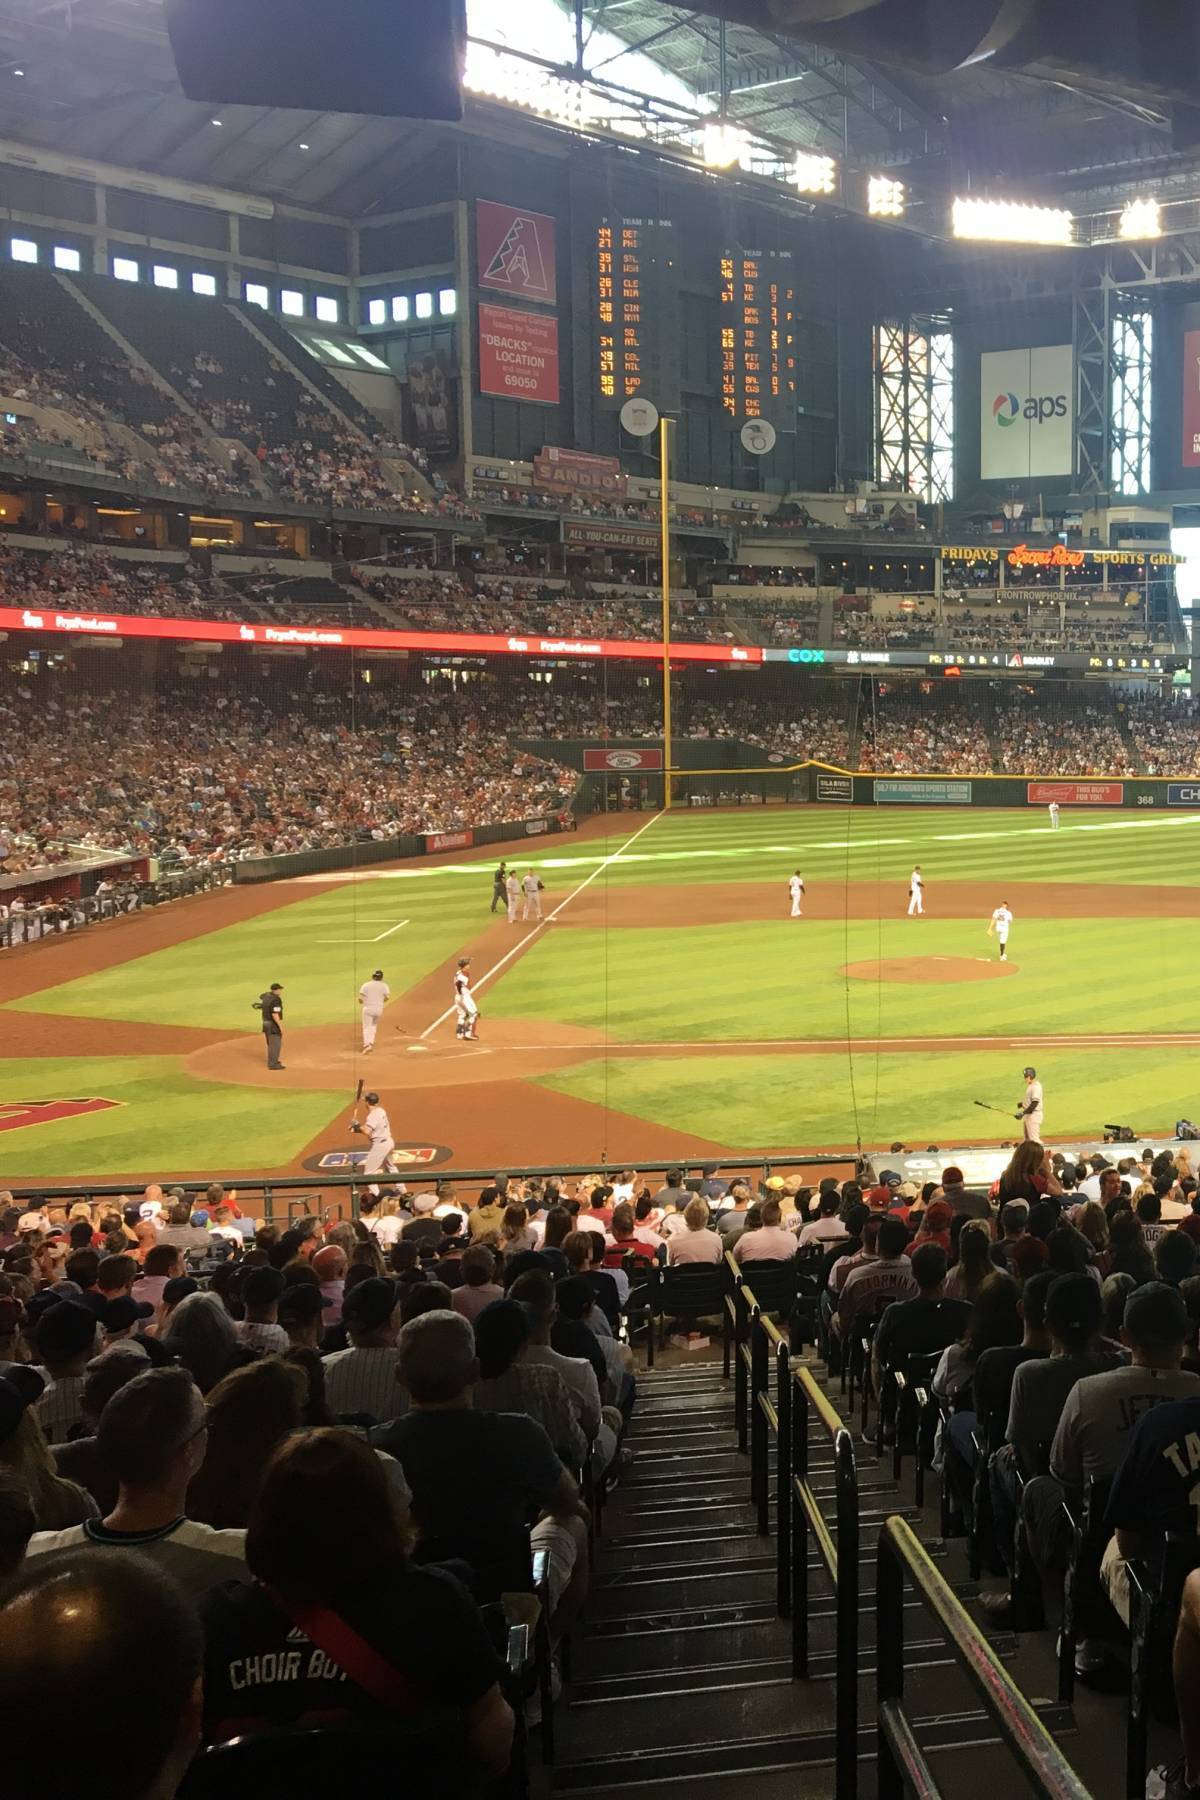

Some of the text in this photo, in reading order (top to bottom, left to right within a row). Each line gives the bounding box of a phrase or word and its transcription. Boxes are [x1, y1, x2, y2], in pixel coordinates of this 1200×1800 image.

[599, 228, 638, 238] 44 DET
[599, 239, 637, 248] 27 PHI
[600, 252, 611, 262] 39
[600, 263, 611, 272] 31
[721, 259, 733, 268] 54
[721, 269, 733, 278] 46
[623, 280, 638, 288] CLE
[600, 288, 612, 297] 31
[721, 292, 733, 301] 57
[624, 304, 639, 312] CIN
[600, 313, 612, 322] 48
[495, 350, 545, 368] LOCATION
[600, 351, 612, 360] 49
[600, 362, 613, 371] 57
[505, 375, 537, 389] 69050
[601, 386, 636, 395] 40 SF
[723, 398, 734, 406] 34
[1023, 395, 1067, 424] aps
[636, 536, 658, 546] SEATS
[941, 549, 999, 560] FRIDAYS
[1093, 552, 1145, 564] SPORTS
[787, 648, 825, 662] COX
[944, 655, 954, 664] 12
[1023, 656, 1055, 666] BRADLEY
[1137, 796, 1154, 805] 368
[229, 1651, 302, 1690] CHOIR
